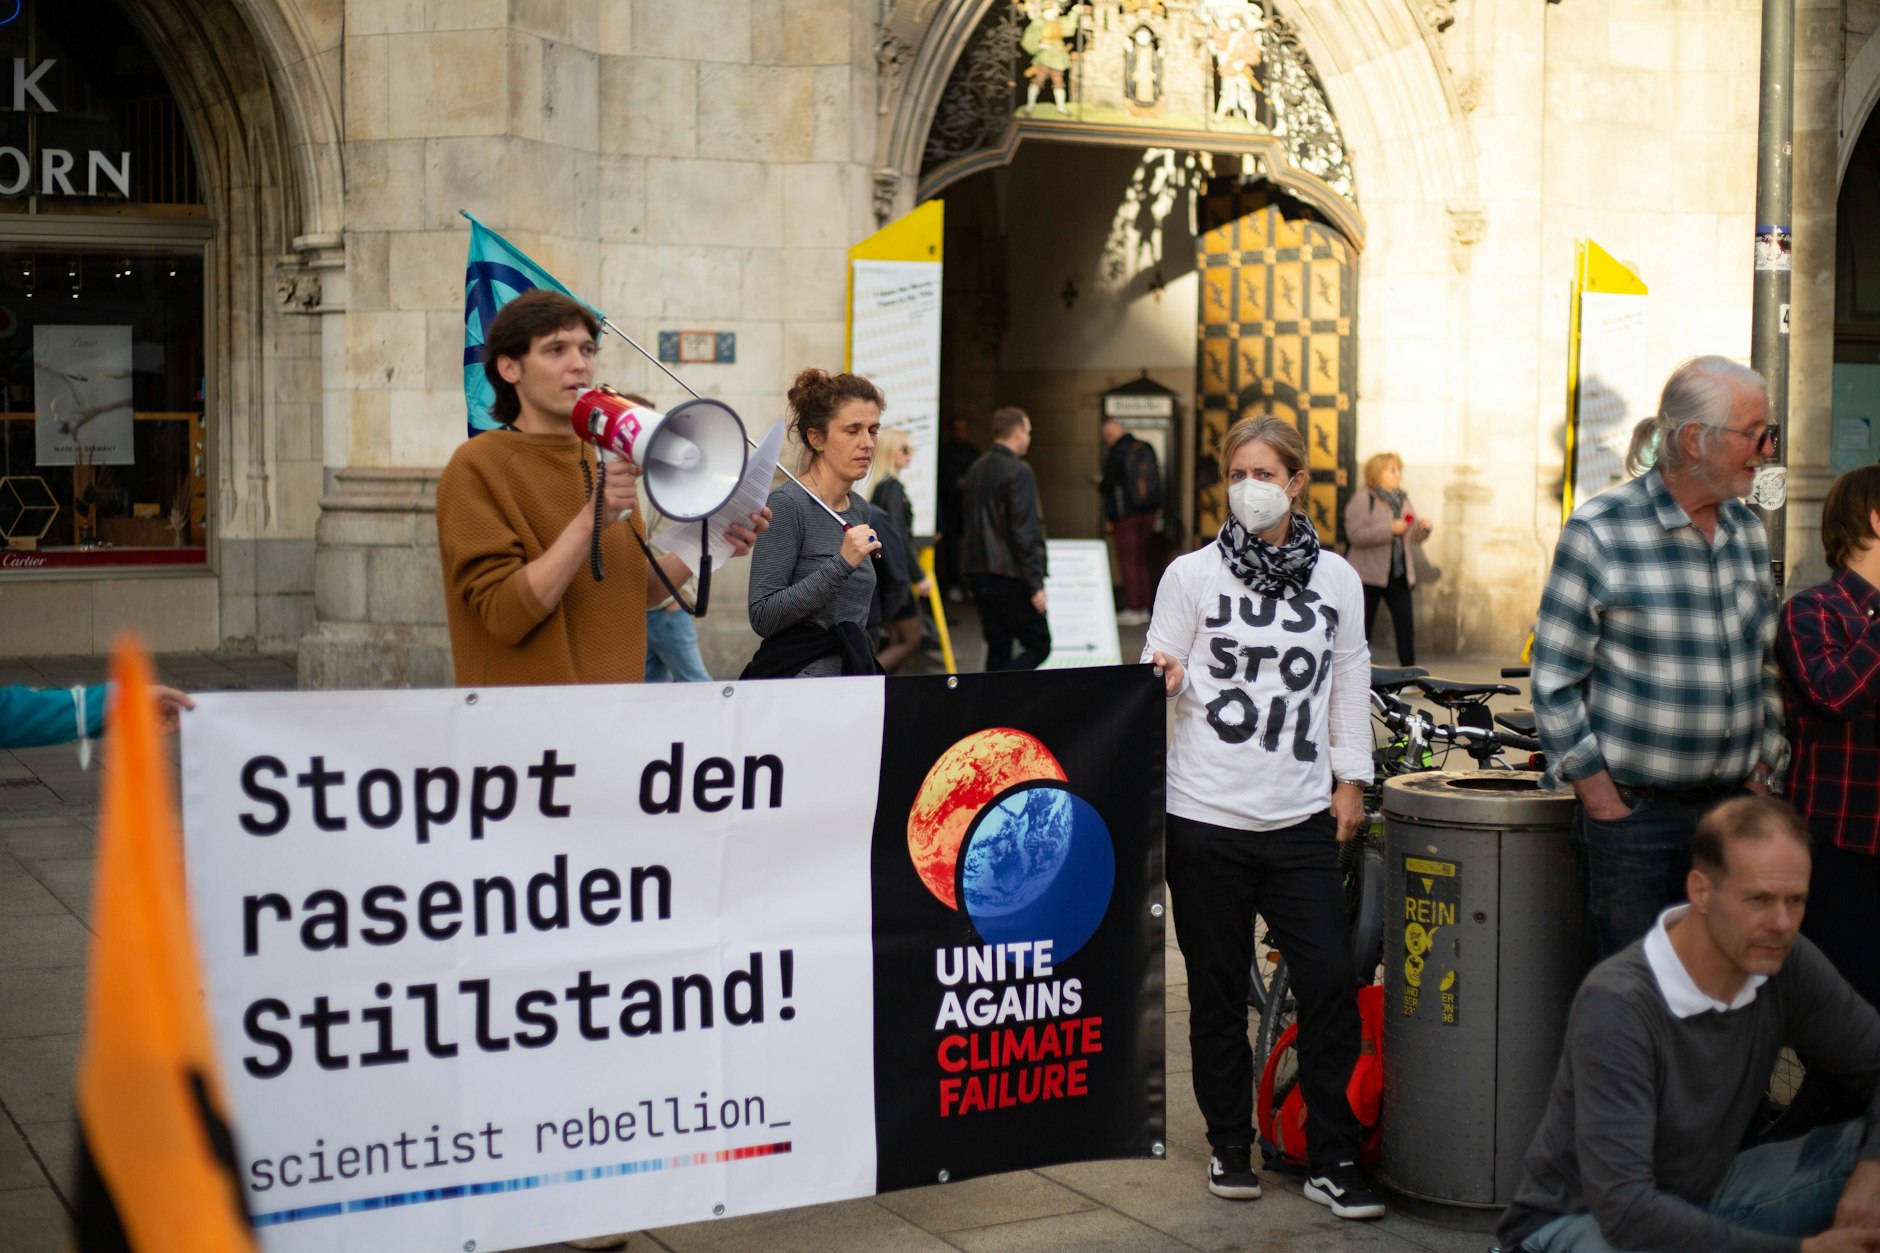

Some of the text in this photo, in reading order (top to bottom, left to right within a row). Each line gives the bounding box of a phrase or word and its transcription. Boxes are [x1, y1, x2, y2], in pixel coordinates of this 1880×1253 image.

[13, 57, 59, 112] K
[2, 553, 47, 568] Cartier
[1205, 687, 1319, 763] OIL
[238, 742, 784, 844] Stoppt den
[242, 854, 672, 957] rasenden
[1404, 896, 1454, 925] REIN
[936, 939, 1054, 986] UNITE
[242, 948, 796, 1080] Stillstand!
[935, 978, 1083, 1031] AGAINS
[937, 1016, 1103, 1073] CLIMATE
[939, 1059, 1089, 1118] FAILURE
[250, 1122, 503, 1192] scientist
